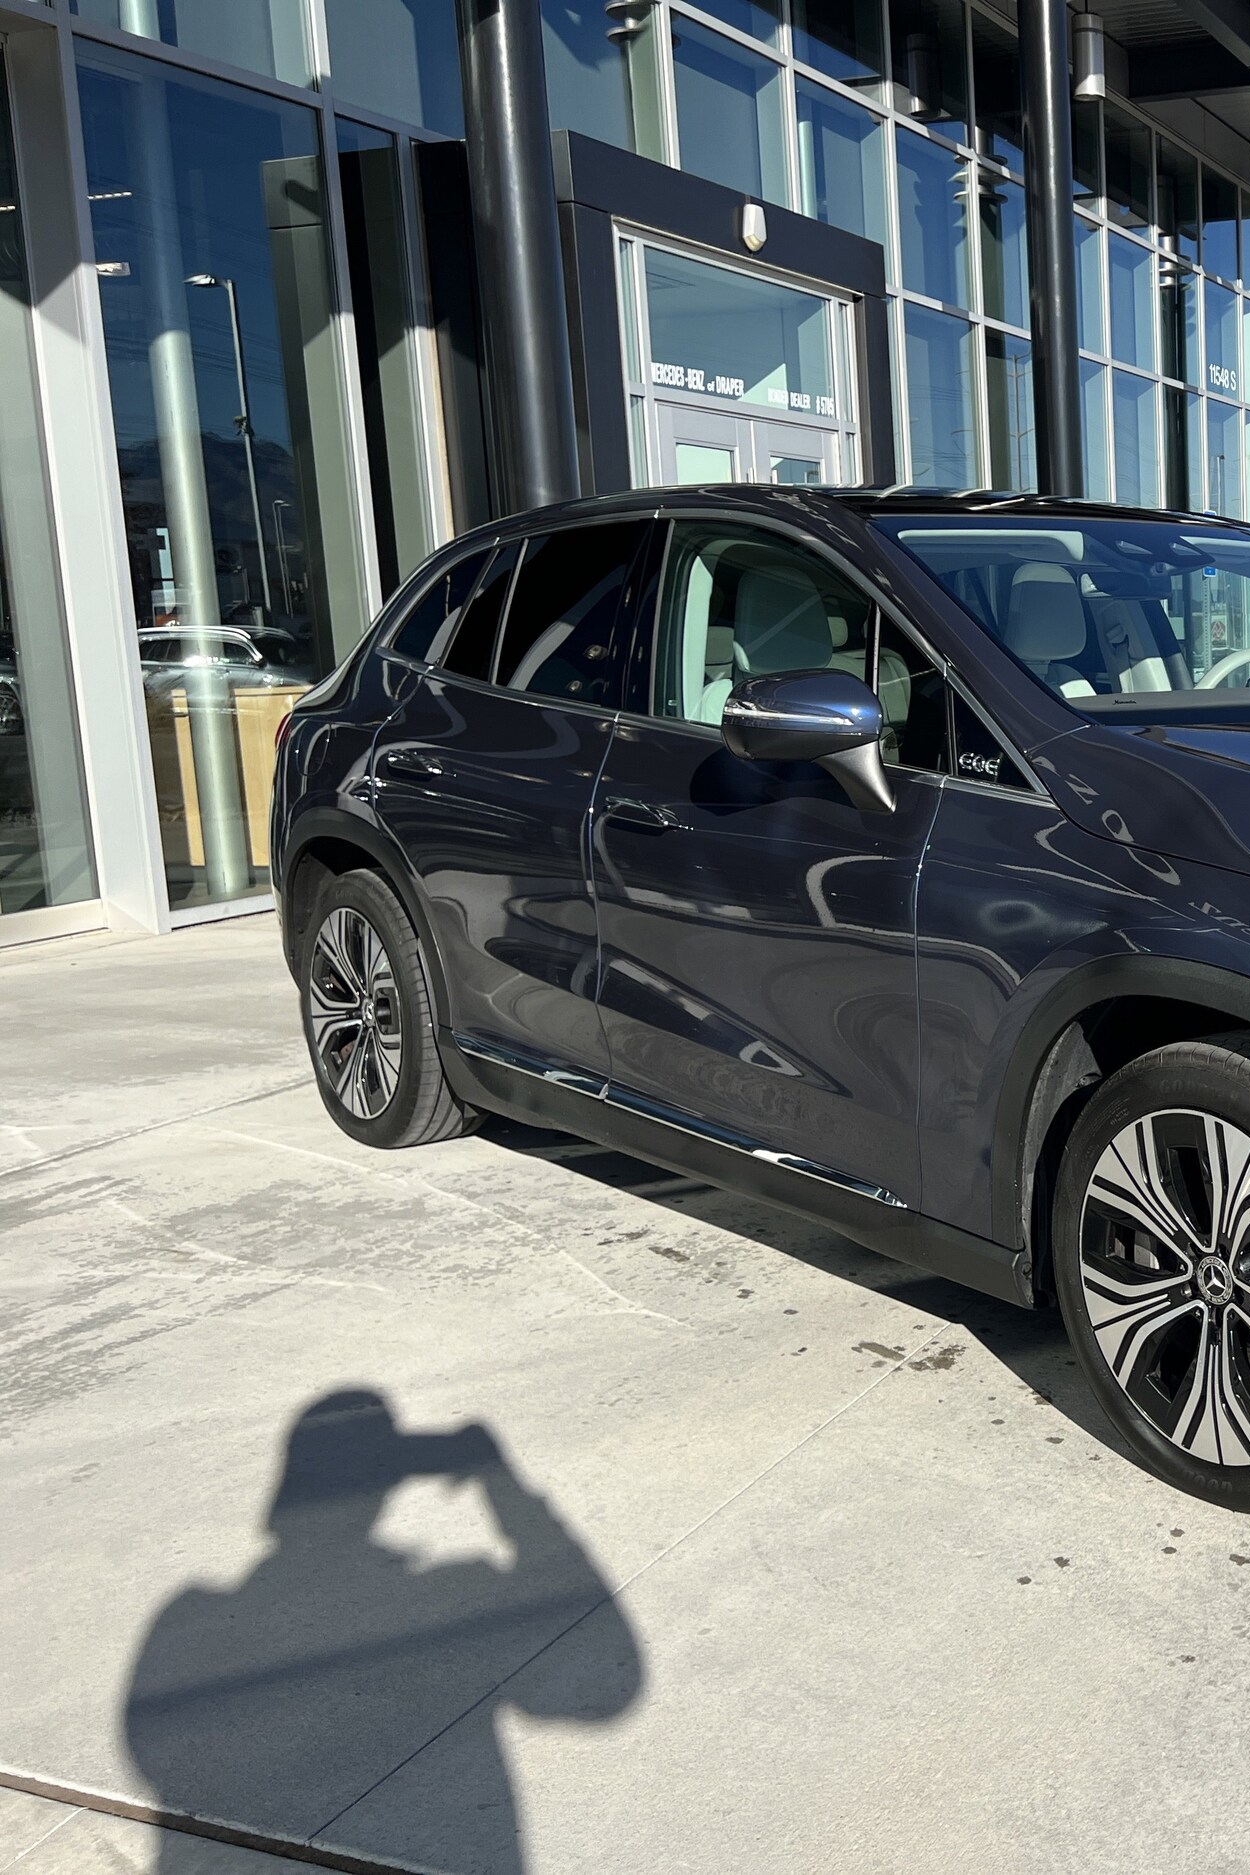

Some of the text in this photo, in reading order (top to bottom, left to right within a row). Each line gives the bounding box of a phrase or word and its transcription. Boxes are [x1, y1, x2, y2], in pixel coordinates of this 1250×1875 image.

[707, 381, 715, 392] of
[716, 375, 744, 397] DRAPER
[1209, 363, 1237, 391] 11548 S
